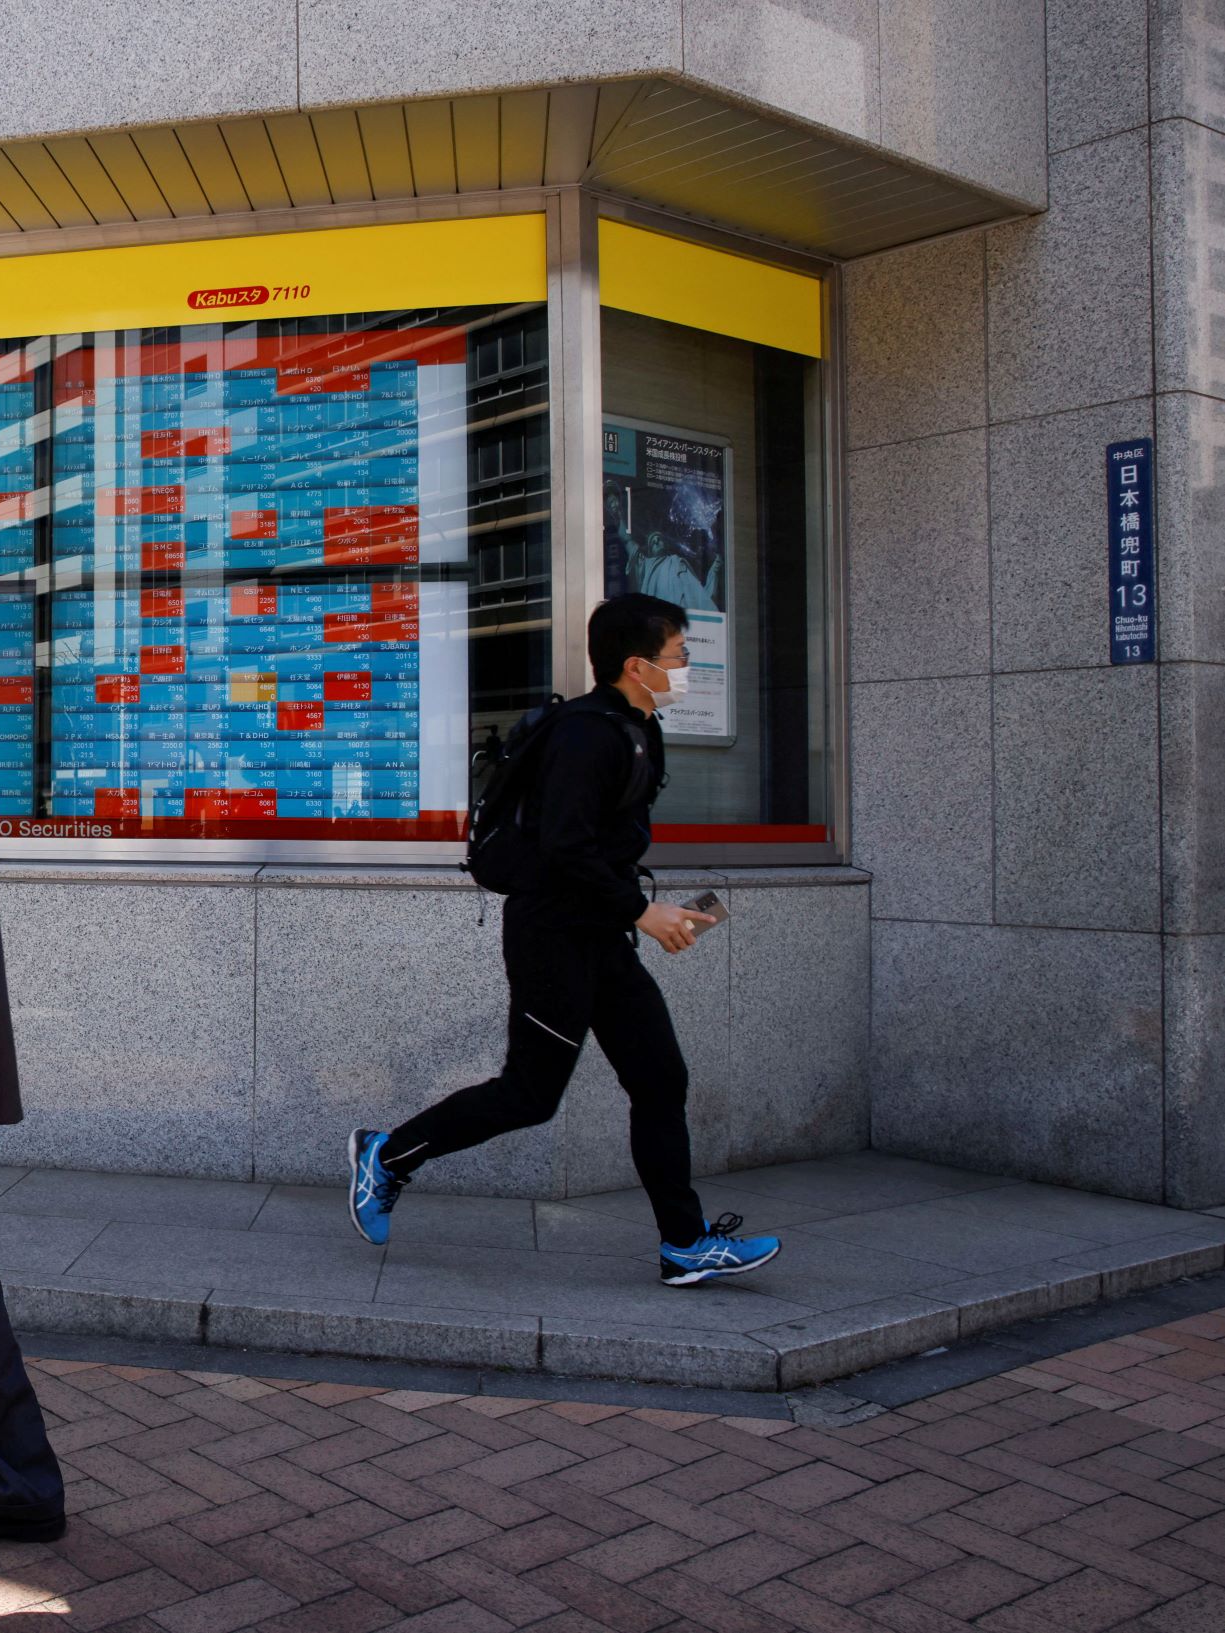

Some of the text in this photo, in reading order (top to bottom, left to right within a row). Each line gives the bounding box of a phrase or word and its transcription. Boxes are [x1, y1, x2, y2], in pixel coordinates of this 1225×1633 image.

[196, 285, 310, 306] Kabuスタ 7110
[1113, 448, 1144, 460] 中央区
[1120, 465, 1140, 577] 日本橋兜町
[1117, 584, 1146, 607] 13
[1115, 614, 1148, 624] Chuo-ku
[1115, 623, 1148, 633] Nihonbashi
[1124, 645, 1140, 657] 13
[19, 820, 112, 837] Securities
